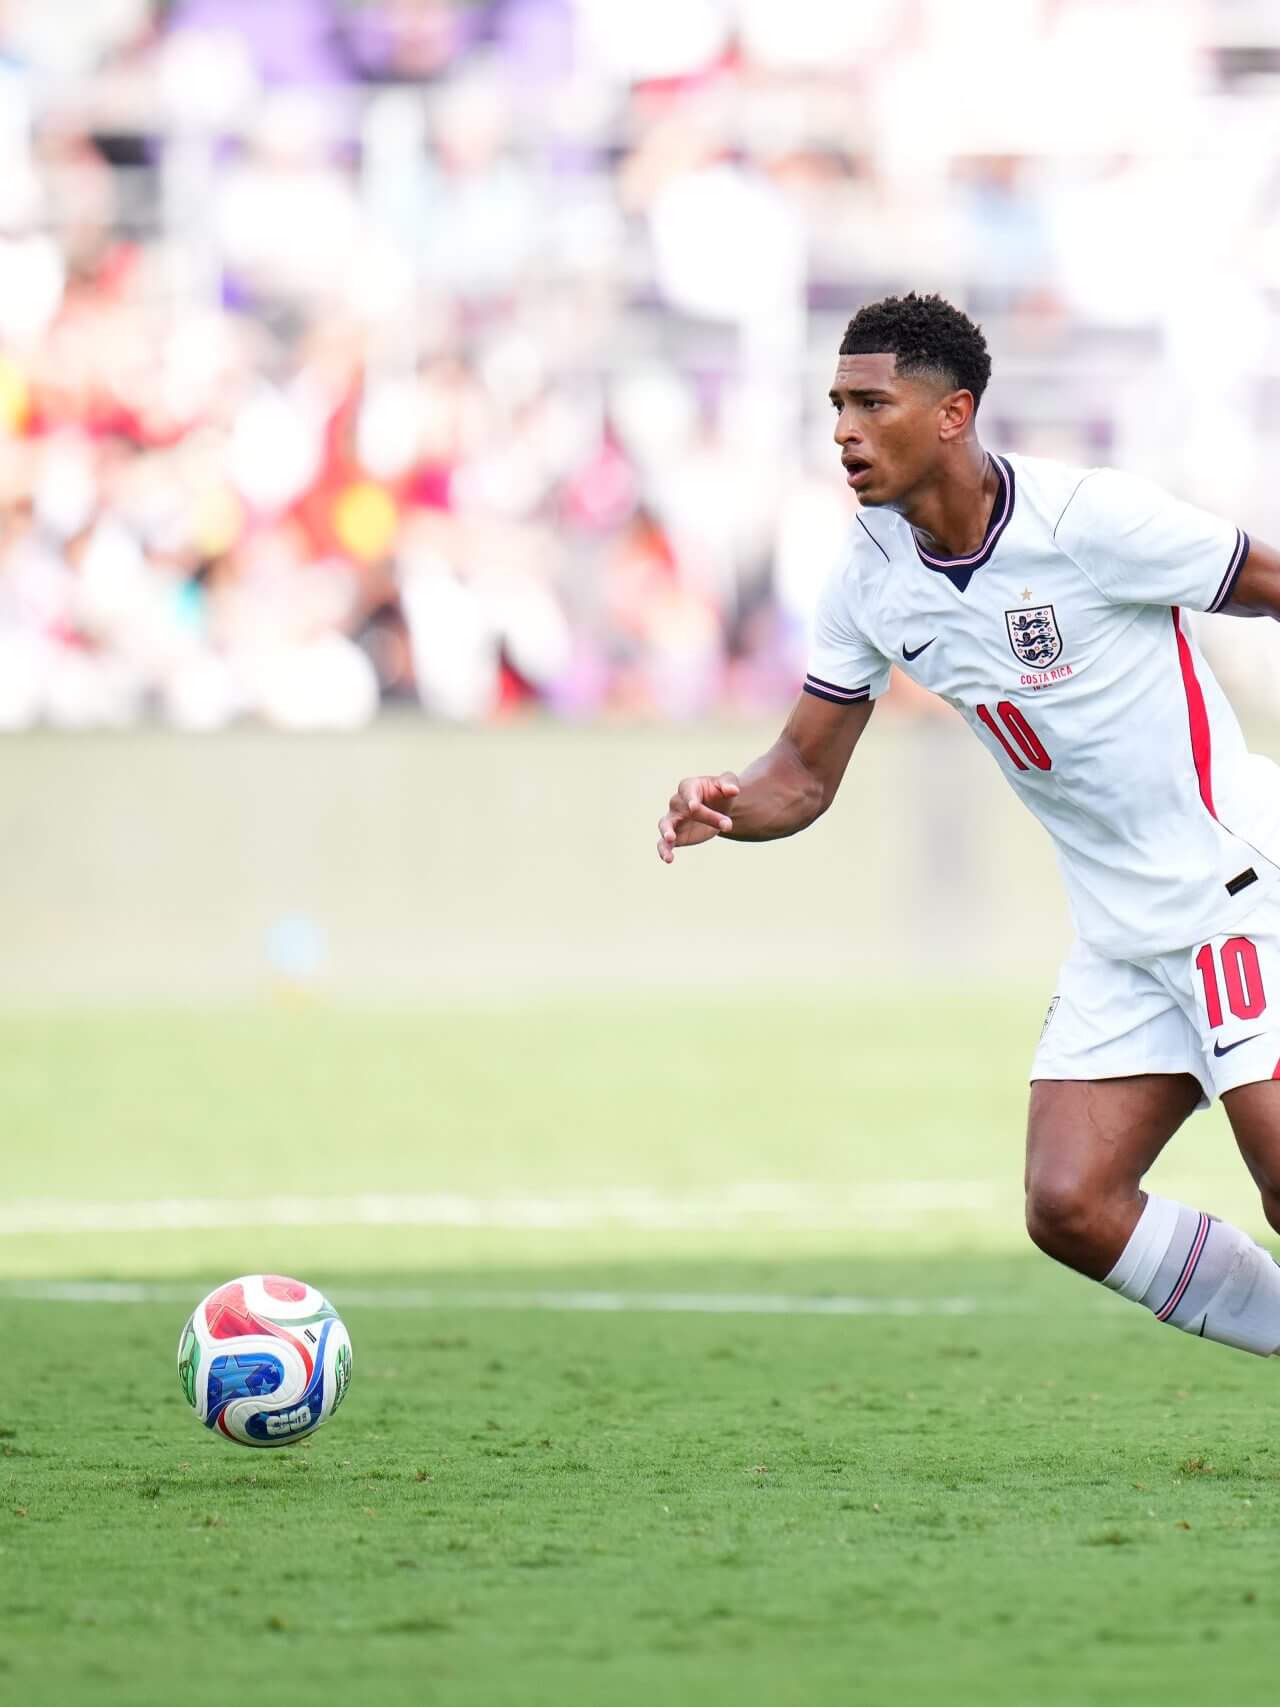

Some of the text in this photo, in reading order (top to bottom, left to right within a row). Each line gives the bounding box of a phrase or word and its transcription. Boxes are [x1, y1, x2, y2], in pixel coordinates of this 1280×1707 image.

[1020, 664, 1073, 685] COSTA RICA
[976, 701, 1052, 771] 10
[1195, 936, 1267, 1030] 10
